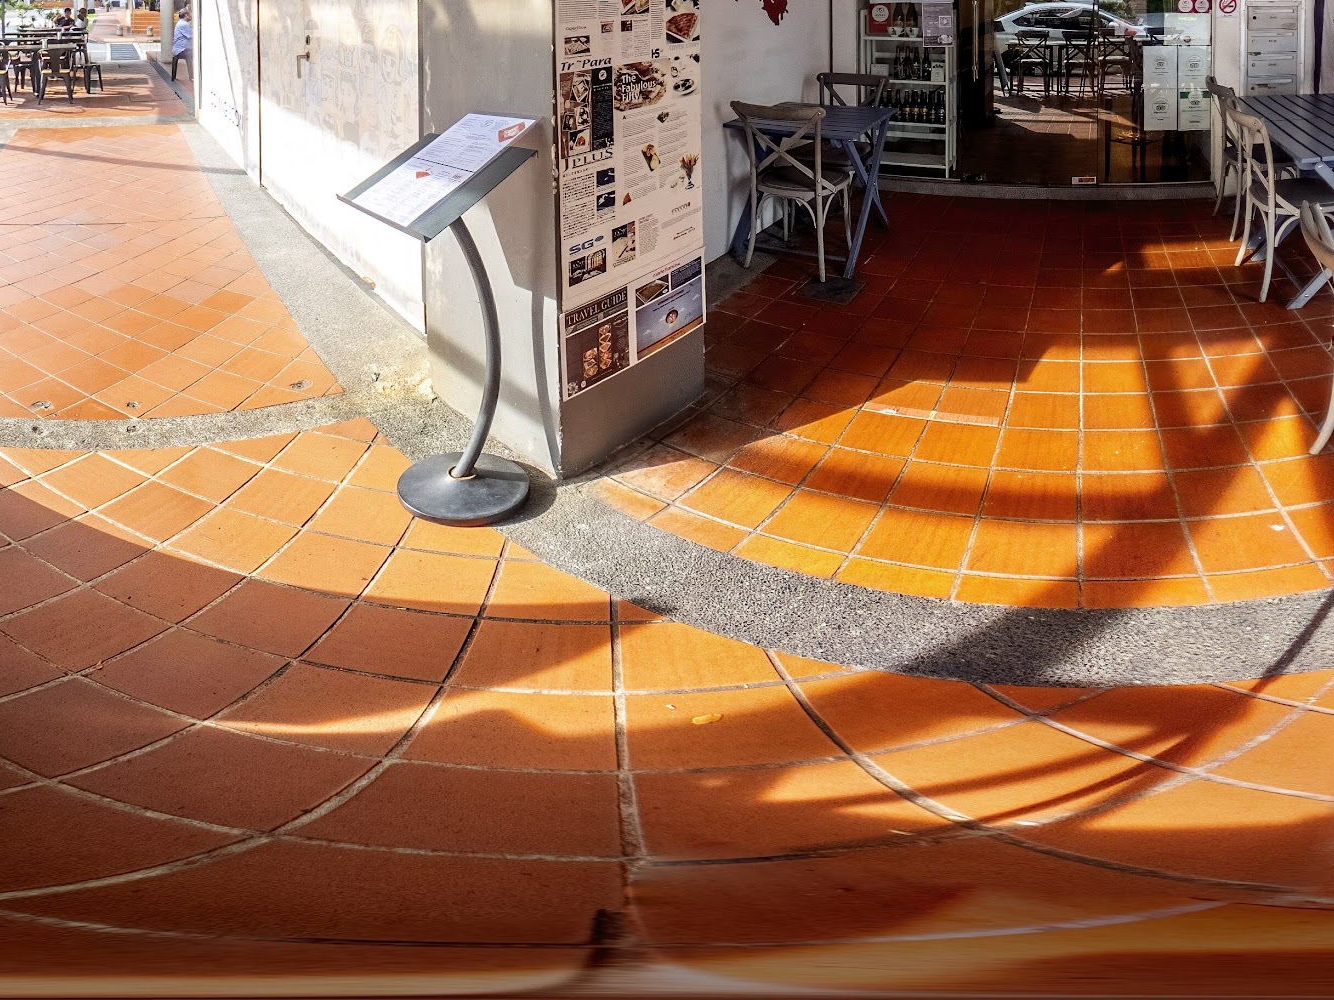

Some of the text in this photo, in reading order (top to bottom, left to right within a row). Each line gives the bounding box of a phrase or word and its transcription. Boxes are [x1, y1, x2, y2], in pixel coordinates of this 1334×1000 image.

[622, 73, 636, 84] The
[621, 79, 657, 93] Fabulous
[566, 290, 627, 325] TRAVEL GUIDE
